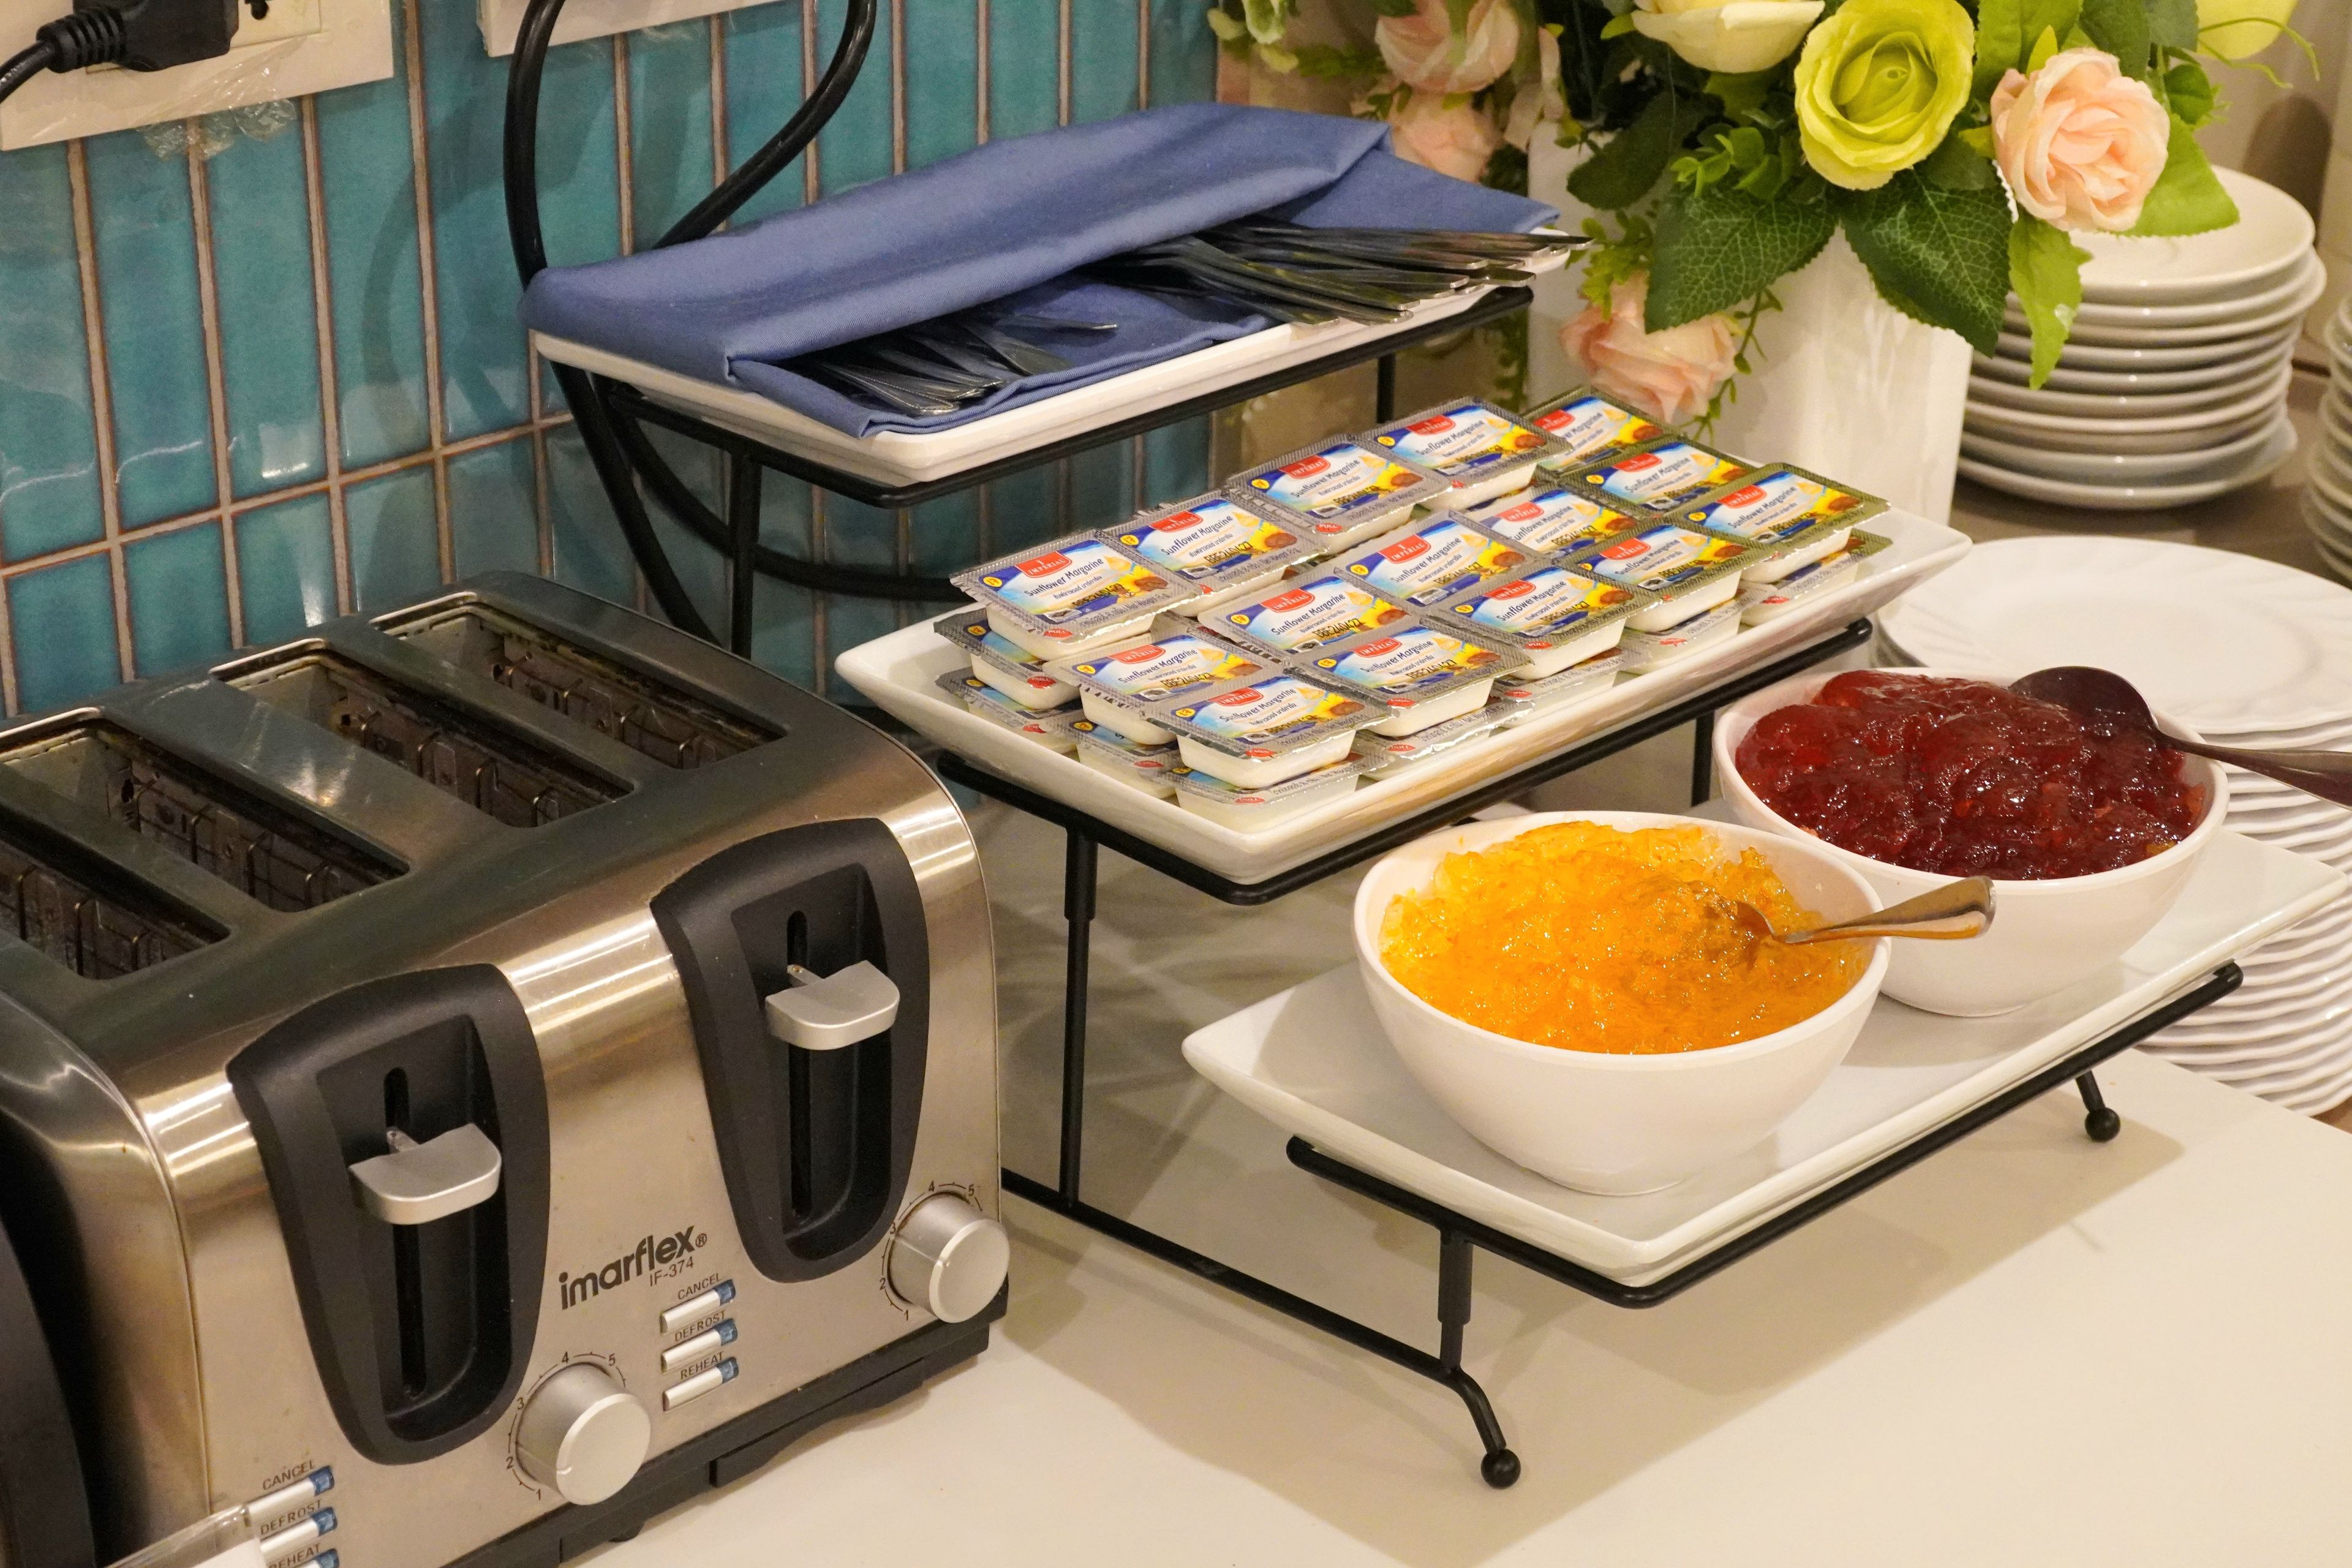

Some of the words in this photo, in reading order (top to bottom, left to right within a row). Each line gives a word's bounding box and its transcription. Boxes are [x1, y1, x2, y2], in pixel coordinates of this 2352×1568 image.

[1291, 476, 1325, 497] Sunflower
[1326, 459, 1360, 480] Margarine
[1728, 506, 1762, 529] Sunflower
[1762, 486, 1797, 509] Margarine
[1161, 532, 1198, 556] Sunflower
[1199, 515, 1233, 538] Margarine
[1204, 541, 1253, 565] BBE240427
[1390, 557, 1427, 582] Sunflower
[1425, 537, 1461, 562] Margarine
[1392, 542, 1425, 559] IMPERIAL
[1028, 558, 1065, 575] IMPERIAL
[1615, 556, 1648, 576] Sunflower
[1024, 576, 1066, 597] Sunflower
[1065, 558, 1104, 581] Margarine
[1495, 583, 1530, 599] IMPERIAL
[1496, 598, 1534, 622] Sunflower
[1532, 580, 1566, 603] Margarine
[1273, 595, 1308, 610] IMPERIAL
[1271, 613, 1310, 636] Sunflower
[1310, 592, 1346, 616] Margarine
[1312, 618, 1362, 638] BBE240427
[1123, 649, 1157, 663] IMPERIAL
[1359, 640, 1396, 655] IMPERIAL
[1359, 655, 1398, 673] Sunflower
[1398, 640, 1434, 660] Margarine
[1118, 665, 1159, 684] Sunflower
[1159, 647, 1197, 667] Margarine
[1219, 692, 1256, 705] IMPERIAL
[1219, 704, 1258, 723] Sunflower
[1259, 687, 1297, 709] Margarine
[928, 1180, 935, 1192] 4
[968, 1184, 975, 1196] 5
[889, 1219, 897, 1234] 3
[650, 1256, 693, 1286] IF-374
[678, 1273, 722, 1300] CANCEL
[880, 1277, 886, 1291] 2
[675, 1310, 725, 1341] DEFROST
[903, 1310, 909, 1321] 1
[562, 1351, 568, 1363] 4
[609, 1353, 616, 1366] 5
[680, 1351, 724, 1379] REHEAT
[516, 1397, 524, 1410] 3
[506, 1456, 513, 1470] 2
[263, 1460, 315, 1490] CANCEL
[536, 1488, 541, 1501] 1
[260, 1499, 323, 1535] DEFROST
